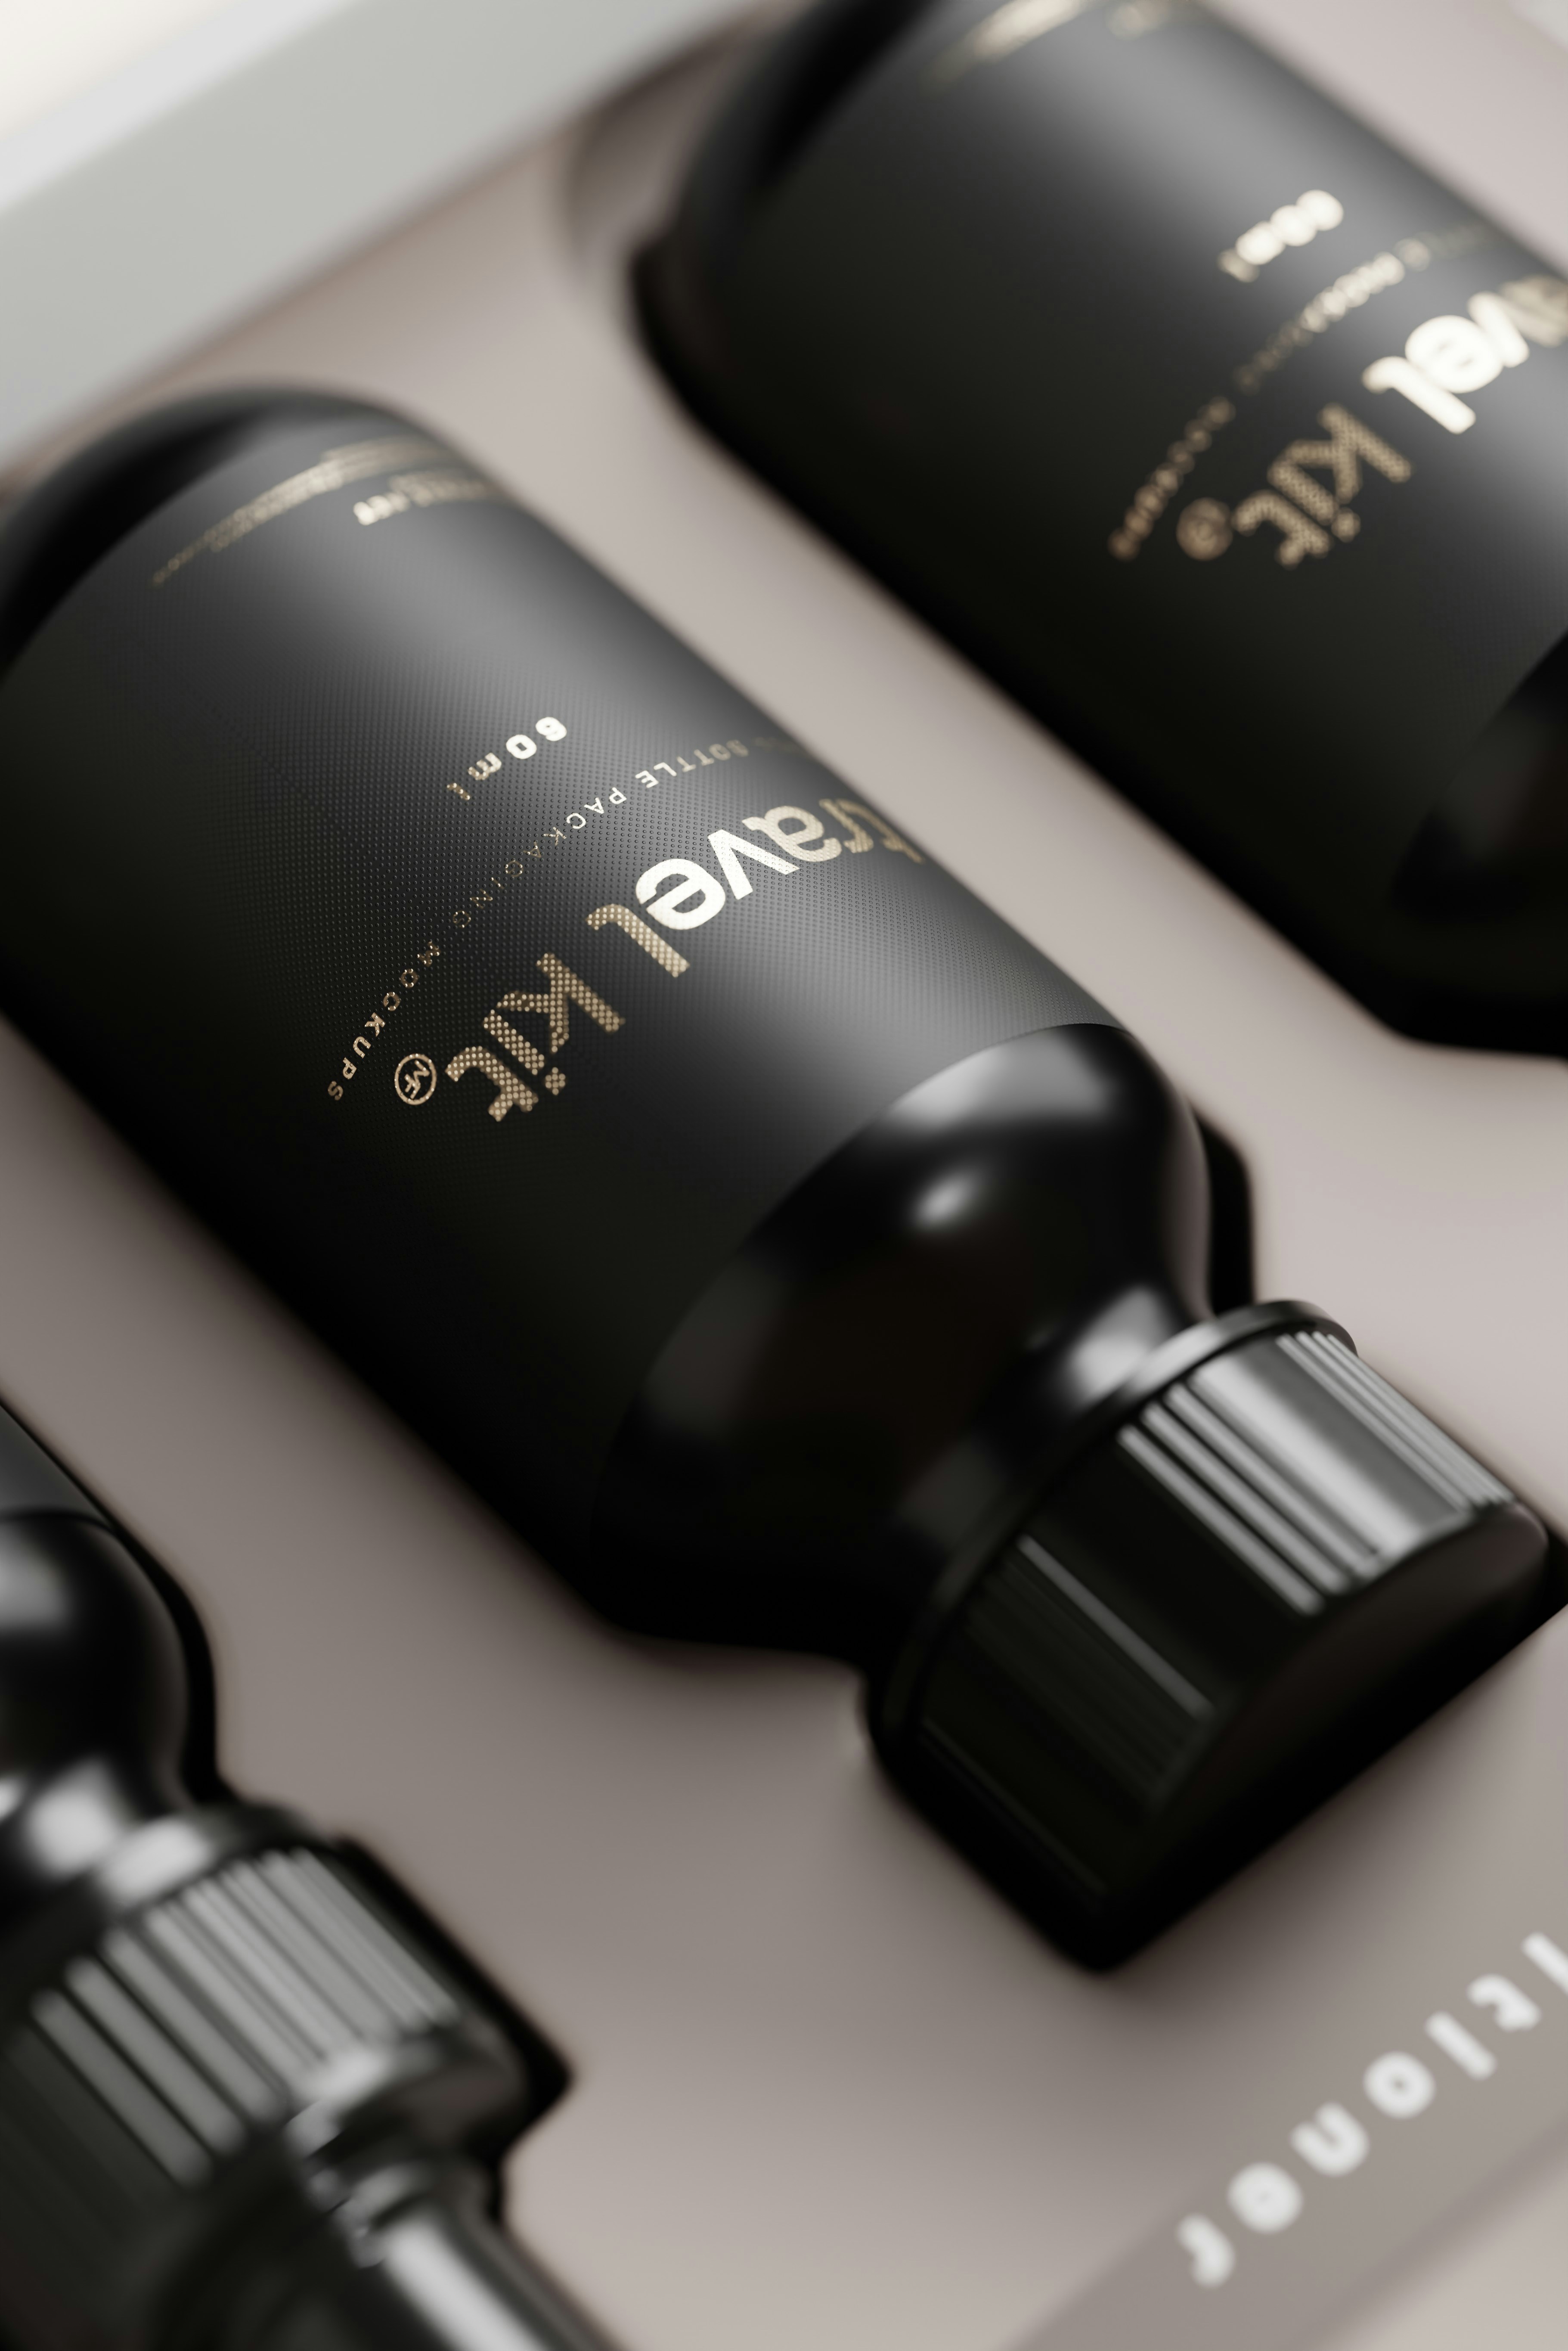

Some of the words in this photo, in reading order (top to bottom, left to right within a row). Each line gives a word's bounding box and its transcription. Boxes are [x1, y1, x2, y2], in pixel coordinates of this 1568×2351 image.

[1233, 403, 1413, 568] kit
[635, 738, 749, 788] BOTTLE
[451, 787, 627, 929] PACKAGING
[586, 797, 923, 977] travel
[327, 940, 440, 1101] MOCKUPS
[398, 1056, 434, 1103] MF
[444, 952, 626, 1122] kit
